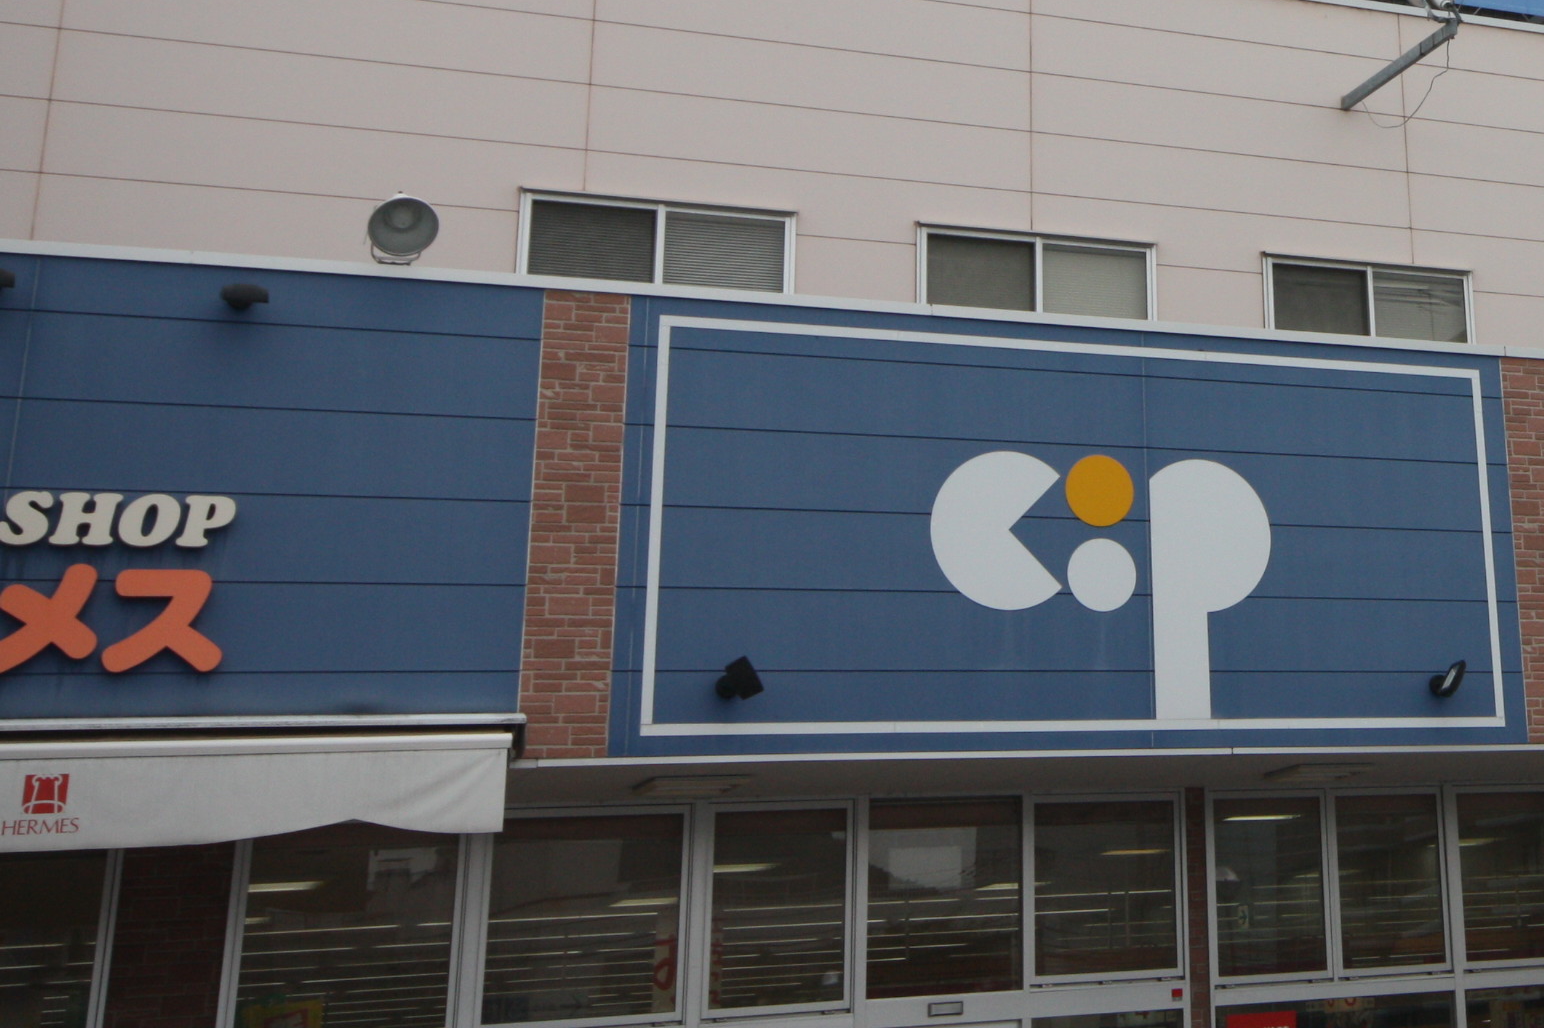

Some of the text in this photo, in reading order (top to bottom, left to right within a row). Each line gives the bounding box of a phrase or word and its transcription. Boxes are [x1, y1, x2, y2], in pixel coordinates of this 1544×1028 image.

[0, 490, 236, 548] SHOP
[0, 563, 222, 673] メス
[1, 817, 80, 836] HERMES
